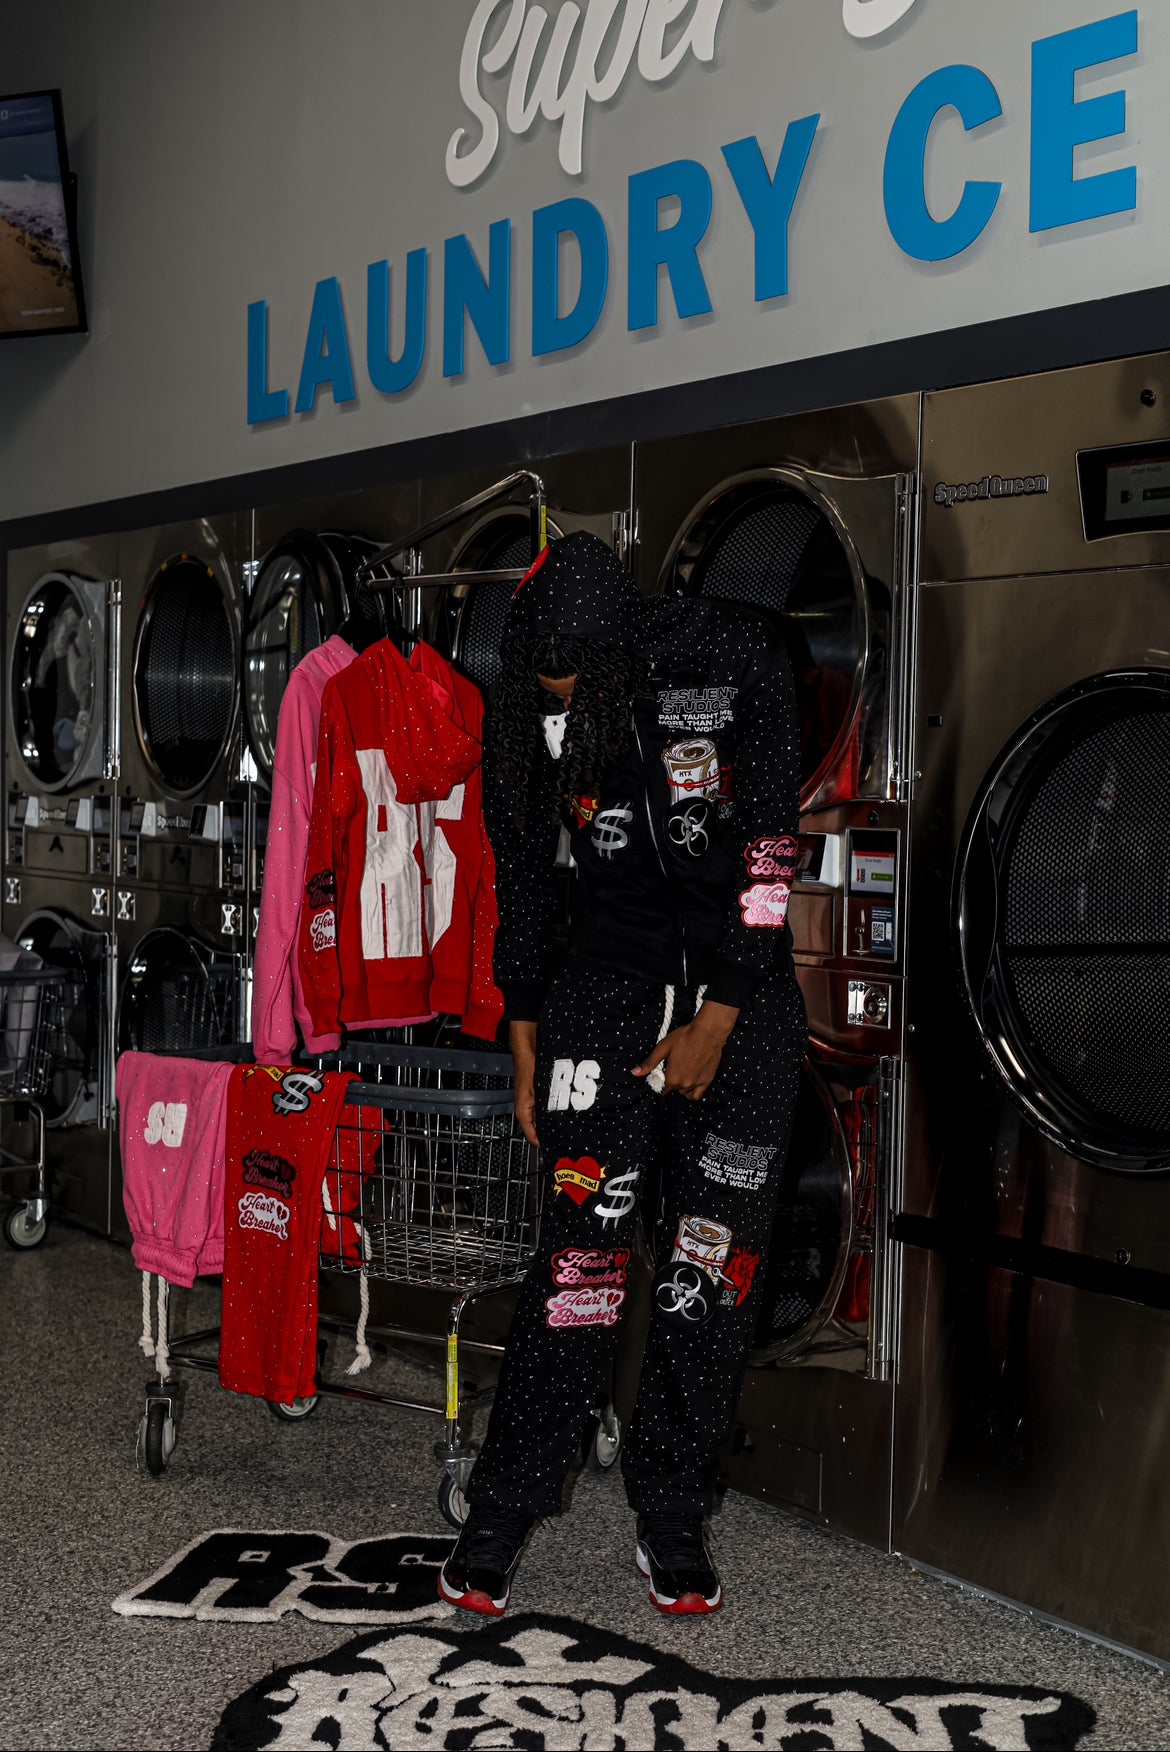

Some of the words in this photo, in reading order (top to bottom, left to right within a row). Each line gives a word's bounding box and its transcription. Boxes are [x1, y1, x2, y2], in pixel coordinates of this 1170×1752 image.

[247, 114, 821, 425] LAUNDRY
[883, 9, 1138, 262] CE
[934, 476, 990, 507] Speed
[989, 475, 1048, 498] Queen
[657, 686, 738, 702] RESILIENT
[662, 698, 730, 714] STUDIOS
[682, 712, 719, 721] TAUGHT
[720, 709, 733, 717] ME
[687, 719, 713, 727] THAN
[548, 1058, 601, 1112] RS
[705, 1132, 778, 1160] RESILIENT
[702, 1155, 721, 1169] PAIN
[723, 1164, 755, 1176] TAUGHT
[756, 1170, 769, 1178] ME
[707, 1146, 769, 1171] STUDIOS
[556, 1172, 575, 1181] hoes
[580, 1176, 598, 1190] mad
[698, 1160, 724, 1177] MORE
[725, 1171, 748, 1182] THAN
[704, 1171, 727, 1184] EVER
[729, 1179, 759, 1191] WOULD
[241, 1195, 276, 1214] Heart
[240, 1210, 287, 1239] Breaker
[558, 1252, 613, 1268] Heart
[556, 1267, 624, 1285] Breaker
[552, 1289, 606, 1309] Heart
[550, 1307, 615, 1325] Breaker
[118, 1531, 458, 1624] RS
